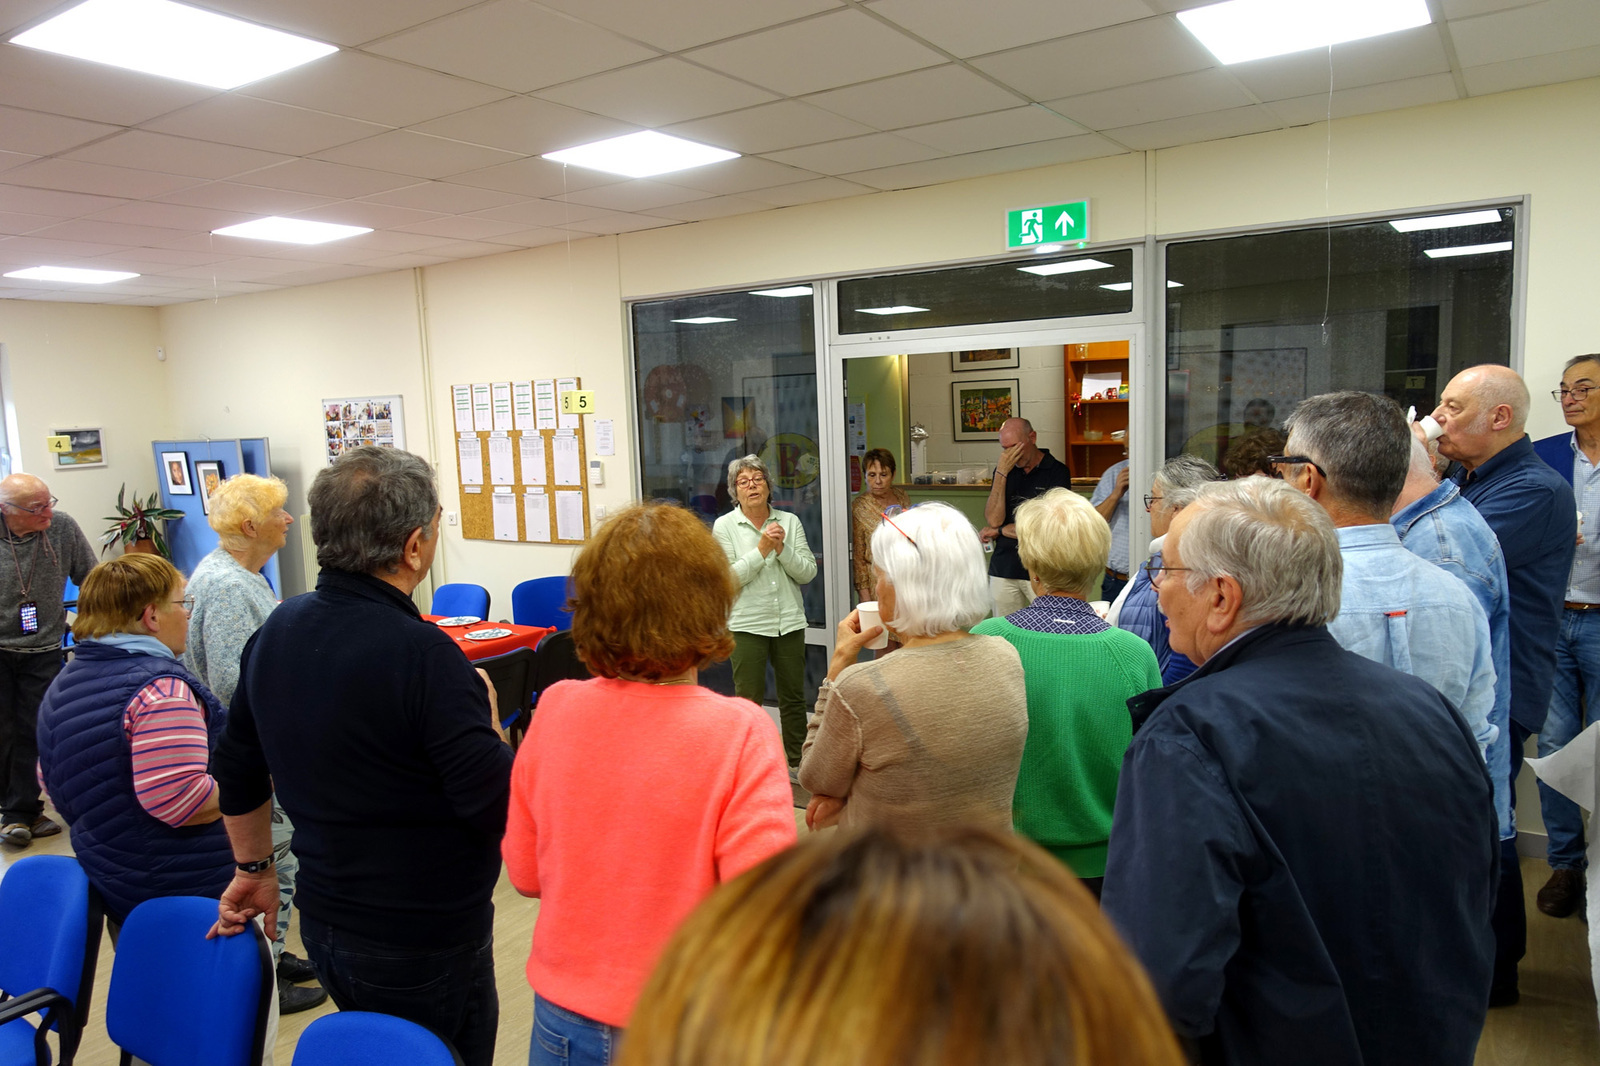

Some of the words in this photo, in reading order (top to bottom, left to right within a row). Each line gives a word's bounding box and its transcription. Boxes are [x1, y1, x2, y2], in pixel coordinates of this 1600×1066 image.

[564, 396, 569, 409] 5
[579, 395, 587, 408] 5
[55, 440, 62, 449] 4
